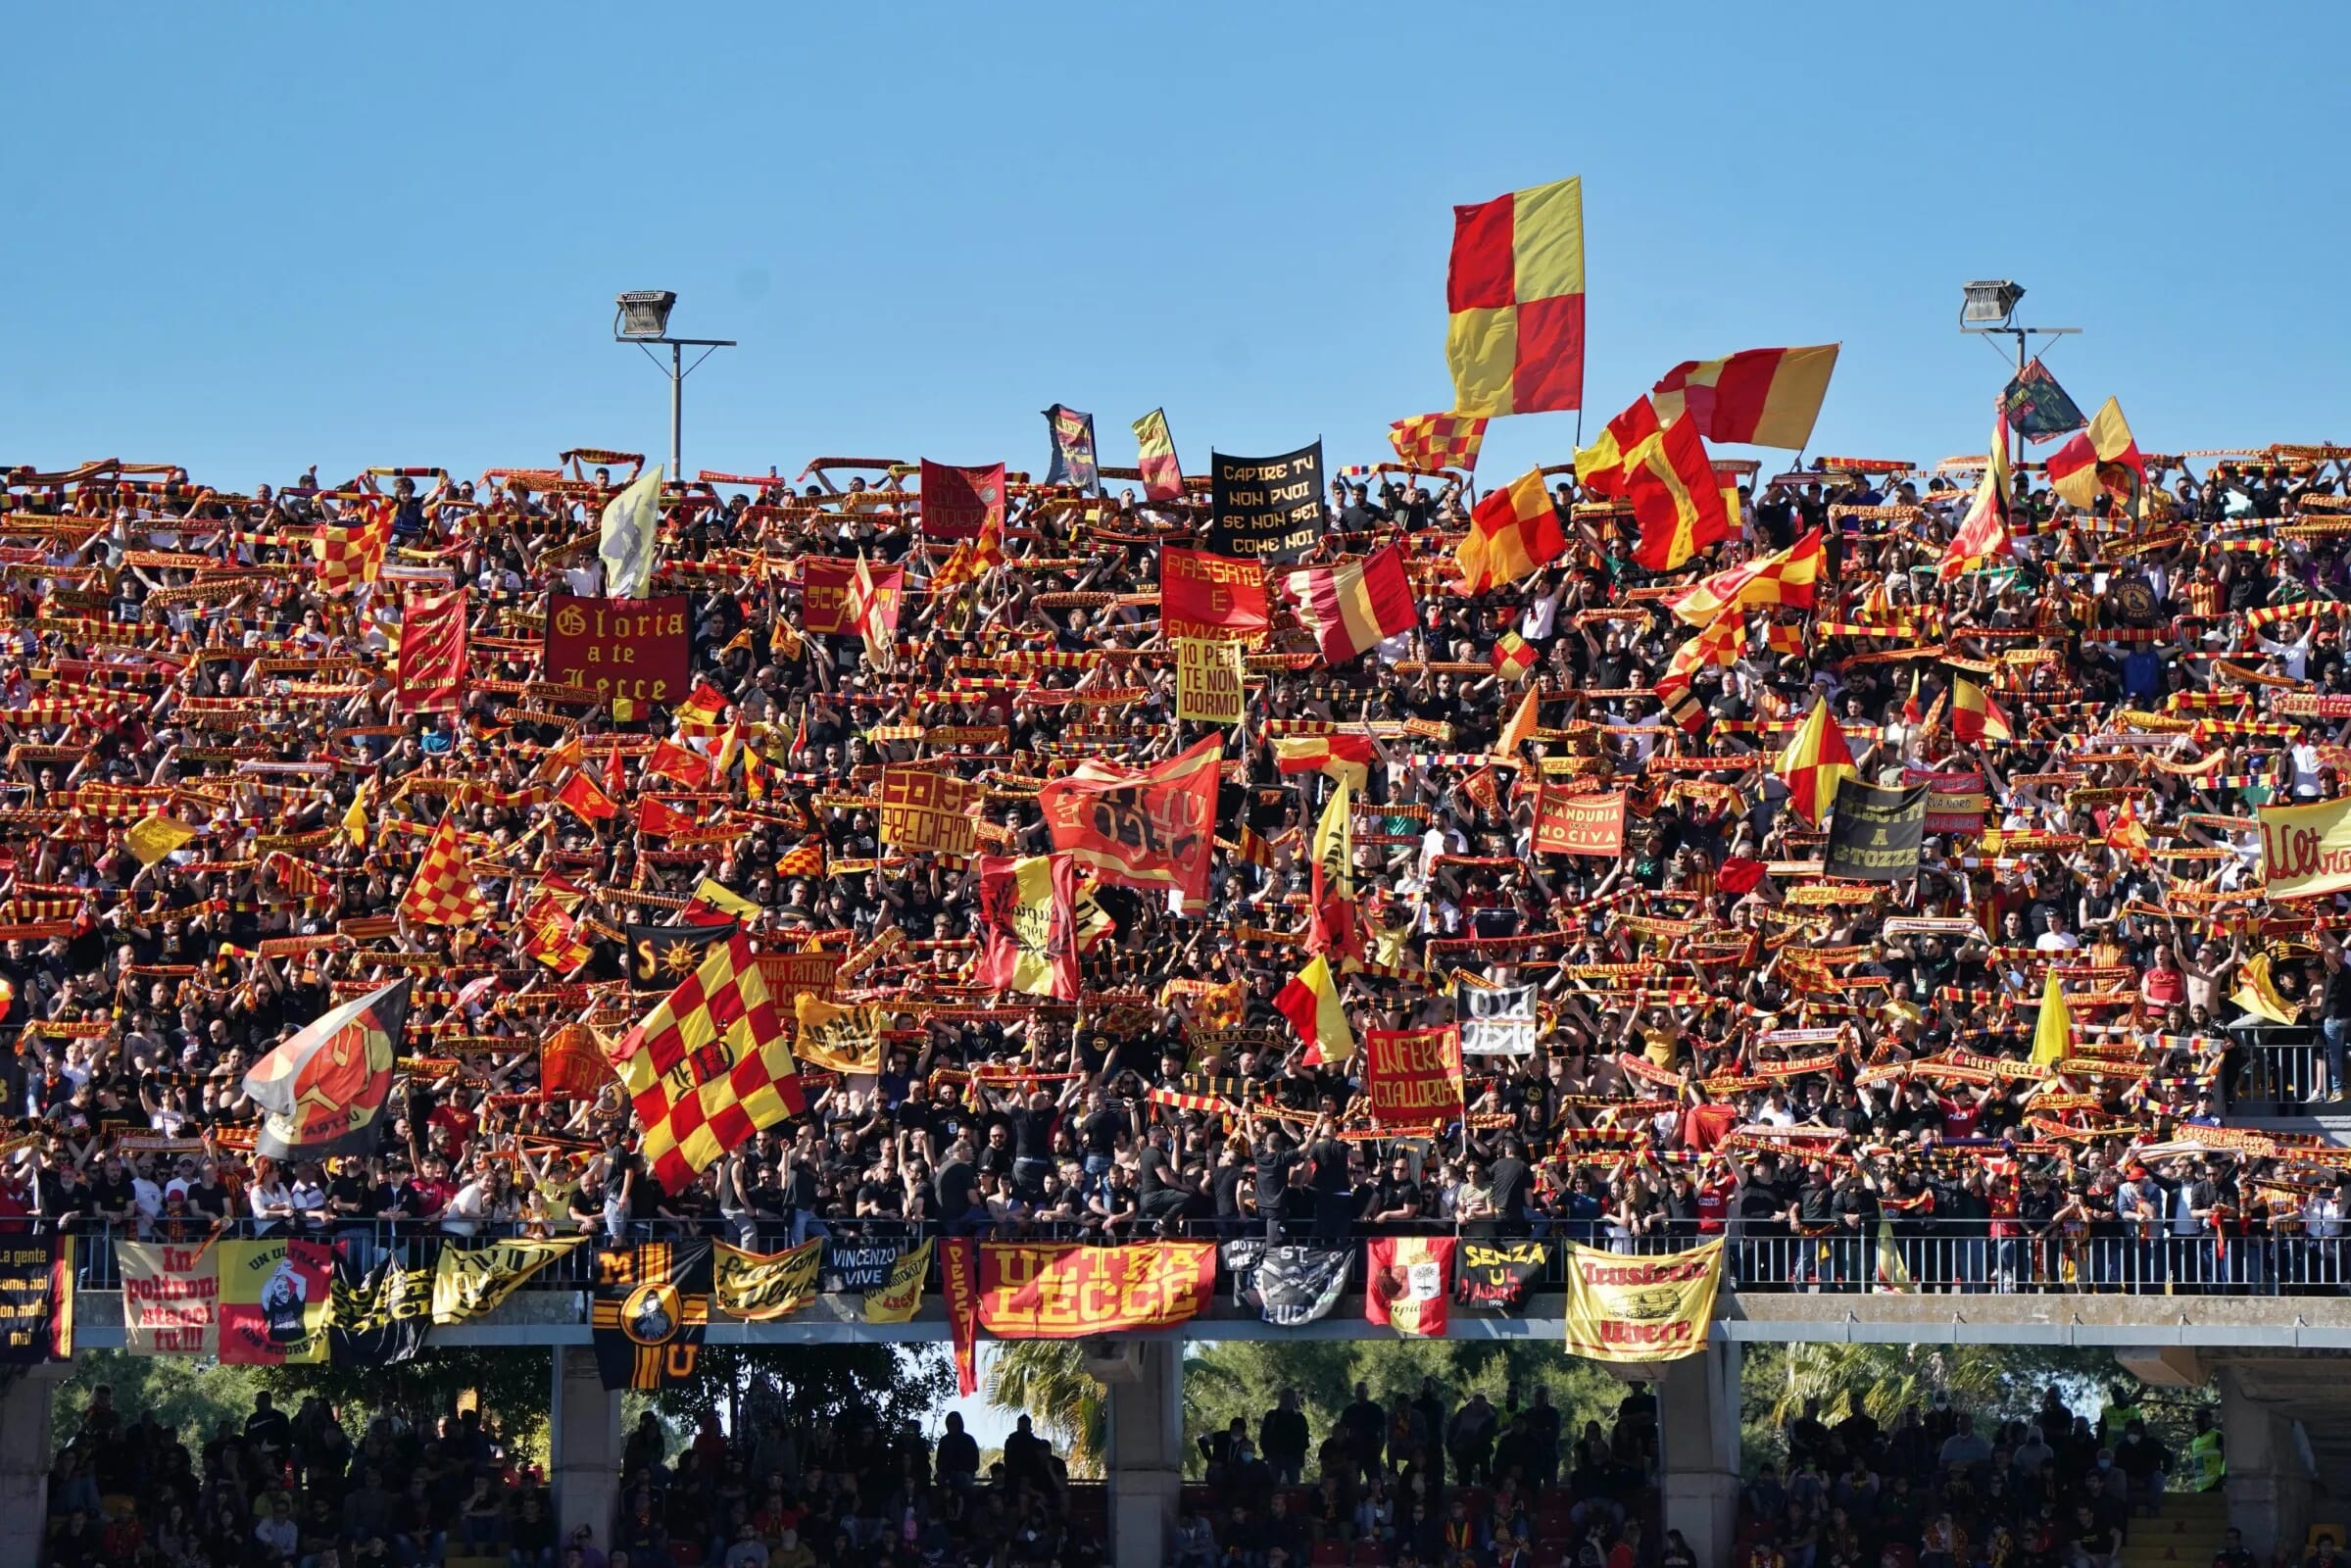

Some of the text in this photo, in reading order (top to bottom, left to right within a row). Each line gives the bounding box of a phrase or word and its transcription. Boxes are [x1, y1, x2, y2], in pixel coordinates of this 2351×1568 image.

[1224, 465, 1288, 482] CAPIRE
[1230, 491, 1263, 507] NON
[924, 505, 1003, 527] MODERO
[1223, 502, 1319, 530] SE NON SEI
[1233, 529, 1314, 556] COME NOI
[1166, 554, 1262, 588] PASSATO
[1211, 590, 1226, 612] E
[556, 603, 685, 636] Gloria
[588, 643, 635, 663] a te
[1183, 643, 1237, 667] IO PER
[404, 675, 456, 691] BAMBINO
[562, 667, 668, 701] Lecce
[1184, 667, 1238, 692] TE NON
[1184, 692, 1239, 716] DORMO
[1407, 720, 1439, 735] LECCE
[1542, 801, 1620, 822] MANDURIA
[1539, 825, 1618, 844] NOCIVA
[1870, 830, 1888, 846] A
[762, 959, 835, 983] MIA PATRIA
[1373, 1030, 1459, 1075] INFERNO
[14, 1248, 47, 1267] gente
[163, 1247, 193, 1272] In
[247, 1253, 270, 1271] UN
[833, 1247, 897, 1267] VINCENZO
[995, 1246, 1201, 1286] ULTRA
[1464, 1242, 1547, 1268] SENZA
[597, 1250, 635, 1286] M
[845, 1269, 883, 1286] VIVE
[30, 1275, 48, 1291] noi
[18, 1298, 48, 1318] molla
[992, 1274, 1199, 1323] LECCE
[141, 1300, 214, 1328] stacci
[11, 1329, 32, 1347] mai
[154, 1327, 205, 1352] tu!!!
[666, 1344, 699, 1378] U
